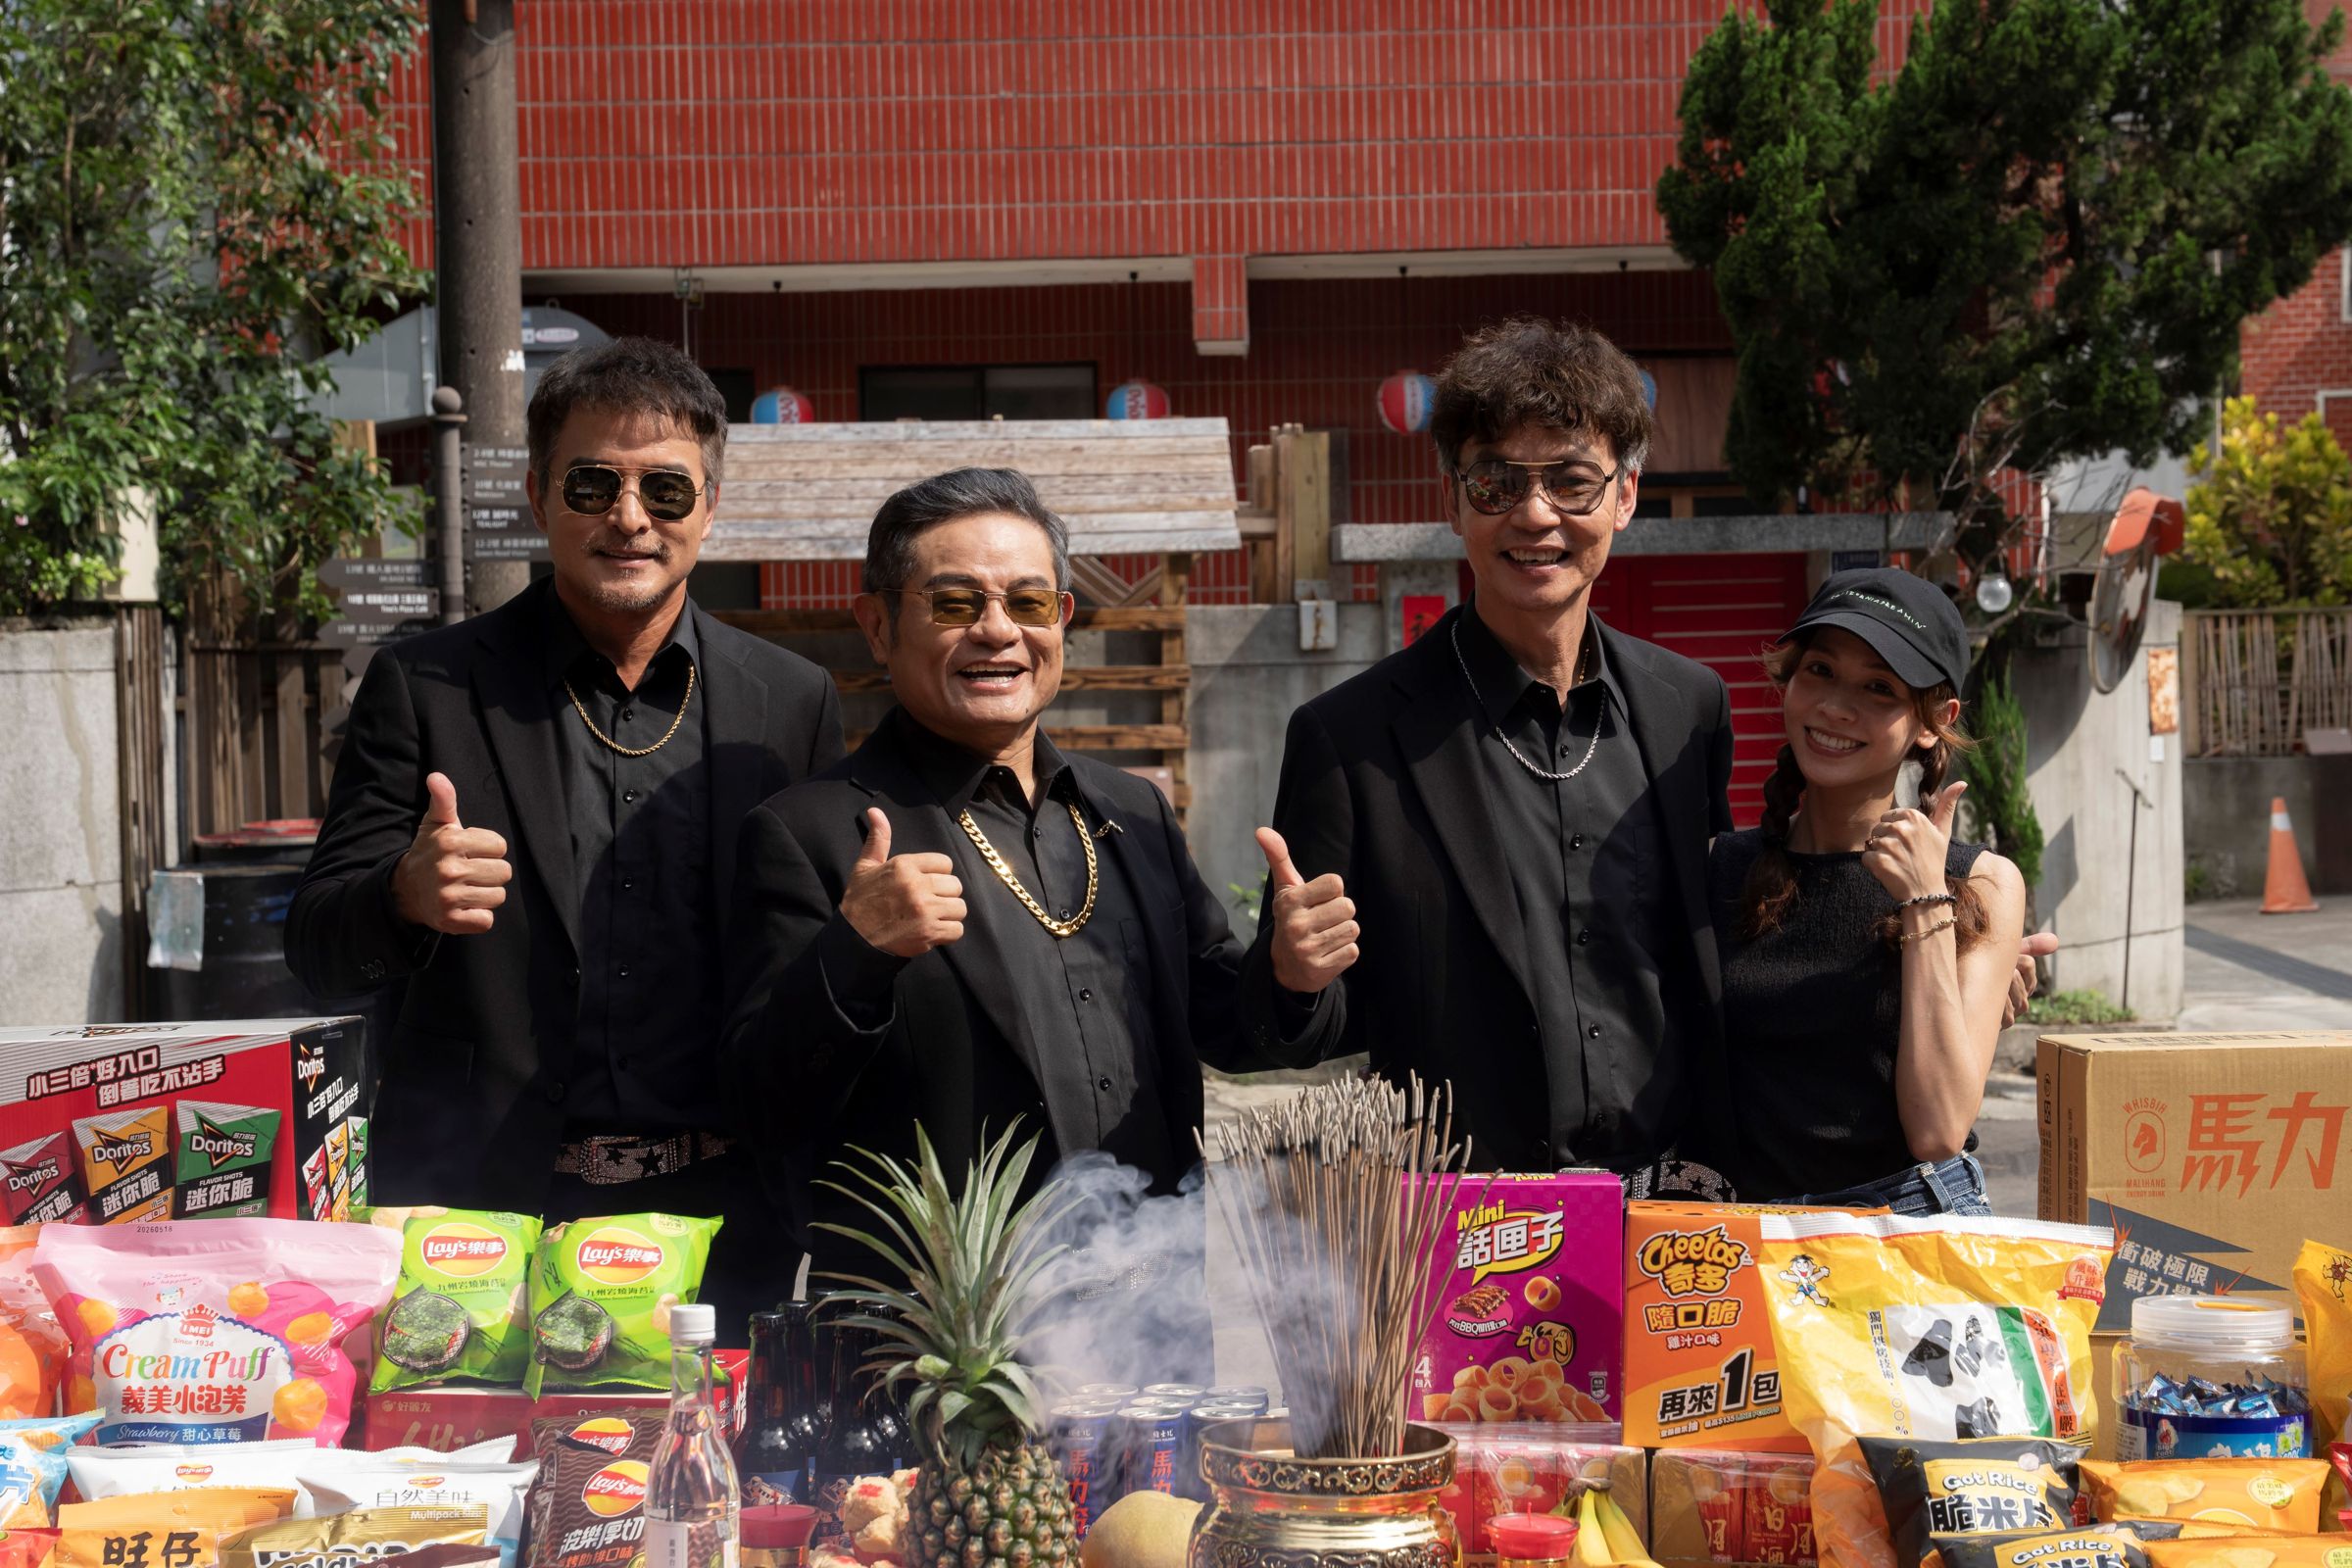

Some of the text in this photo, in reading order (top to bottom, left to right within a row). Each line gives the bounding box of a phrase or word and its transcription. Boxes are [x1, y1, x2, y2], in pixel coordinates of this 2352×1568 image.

[298, 1057, 324, 1080] Doritos
[99, 1056, 224, 1106] 倒著吃不沾手
[2123, 1098, 2168, 1114] WHISBIH
[94, 1140, 152, 1163] Doritos
[192, 1135, 255, 1156] Doritos
[2180, 1092, 2350, 1200] 馬力
[9, 1166, 59, 1191] Doritos
[111, 1177, 129, 1192] FLAVOR
[199, 1171, 243, 1187] FLAVOR SHOTS
[2126, 1178, 2166, 1188] MALIHANG
[102, 1171, 160, 1217] 迷你脆
[185, 1176, 254, 1211] 迷你脆
[1457, 1200, 1505, 1230] Mini
[427, 1240, 467, 1258] Lay's
[1457, 1211, 1564, 1269] 話匣子
[1641, 1225, 1745, 1273] Cheetos
[581, 1246, 624, 1265] Lay's
[2118, 1240, 2210, 1287] 衝破極限
[1663, 1263, 1728, 1295] 奇多
[2123, 1267, 2208, 1296] 戰力覺
[1646, 1300, 1740, 1331] 隨口脆
[1667, 1333, 1720, 1349] 雞汁口味
[102, 1344, 273, 1381] Cream Puff
[1414, 1356, 1432, 1378] 4
[1659, 1348, 1781, 1421] 再來1包
[122, 1384, 247, 1416] 義美小泡芙
[117, 1425, 241, 1443] Strawberry 甜心草莓
[588, 1475, 627, 1494] Lay's
[1944, 1471, 2038, 1495] Got Rice
[411, 1510, 461, 1521] Multipack
[1930, 1494, 2053, 1532] 脆米片
[103, 1531, 201, 1568] 旺仔
[559, 1545, 634, 1568] 烤肋排口味
[2013, 1544, 2055, 1564] Got
[2060, 1540, 2112, 1551] Rice
